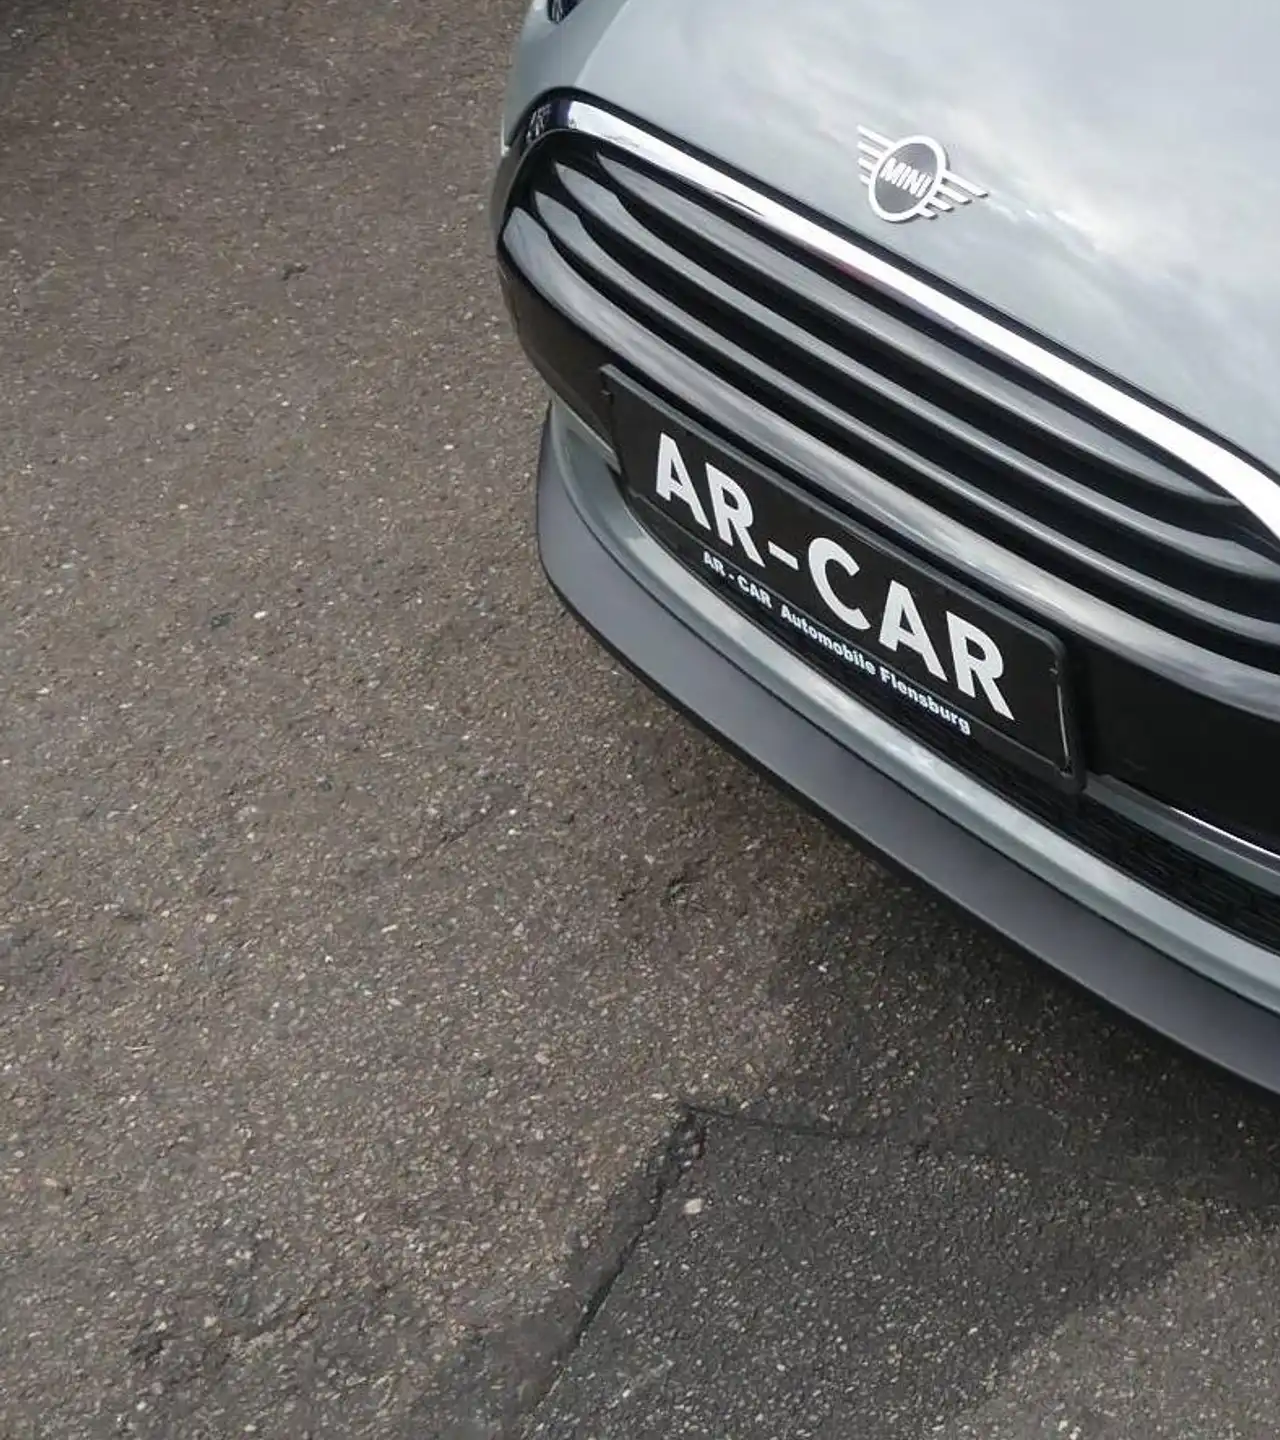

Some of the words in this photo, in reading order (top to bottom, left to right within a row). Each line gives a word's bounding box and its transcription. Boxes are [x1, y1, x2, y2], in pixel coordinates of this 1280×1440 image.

[880, 157, 933, 200] MINI
[655, 431, 1015, 721] AR-CAR
[780, 604, 877, 676] Automobile
[879, 666, 972, 736] Flensburg
